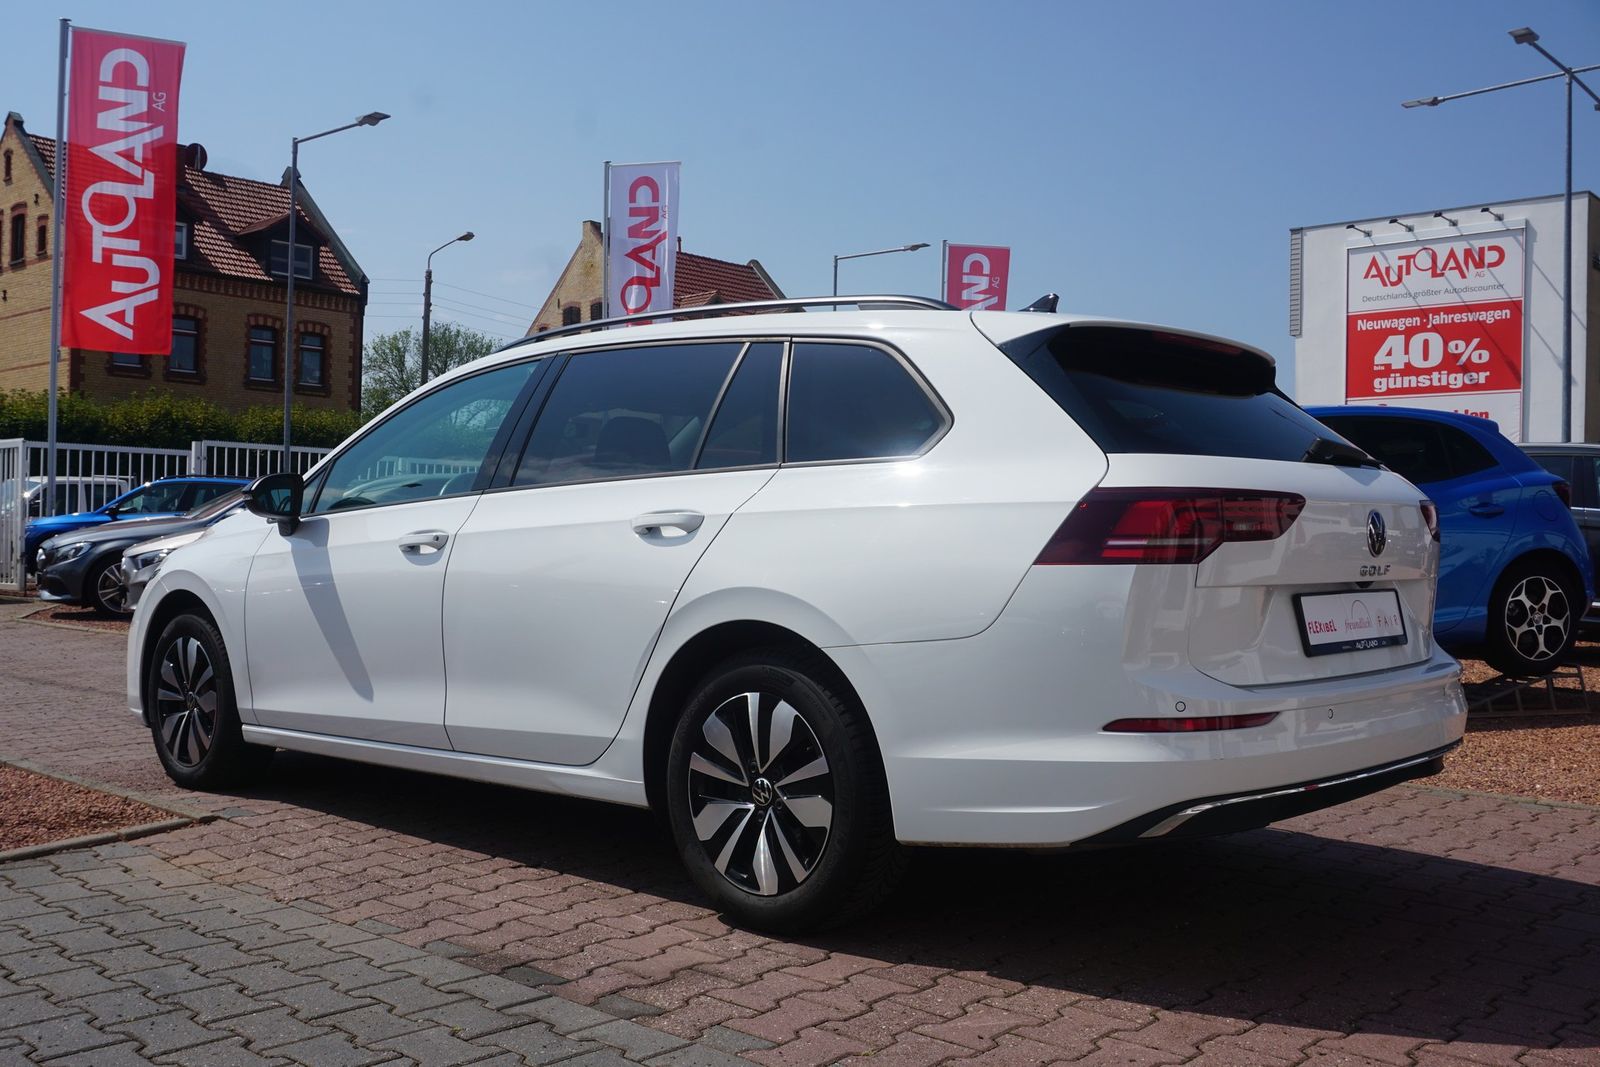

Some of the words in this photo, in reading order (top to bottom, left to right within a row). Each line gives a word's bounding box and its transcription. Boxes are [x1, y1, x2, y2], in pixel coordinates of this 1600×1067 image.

[152, 91, 167, 112] AG
[79, 48, 163, 341] AUTOLAND
[620, 176, 669, 326] OLAND
[1363, 245, 1506, 288] AUTOLAND
[1474, 271, 1486, 279] AG
[1361, 291, 1413, 303] Deutschlands
[1412, 288, 1443, 300] größter
[1443, 283, 1506, 296] Autodiscounter
[1357, 314, 1421, 331] Neuwagen
[1427, 308, 1511, 328] Jahreswagen
[1373, 370, 1490, 393] günstiger
[1359, 564, 1392, 577] GOLF
